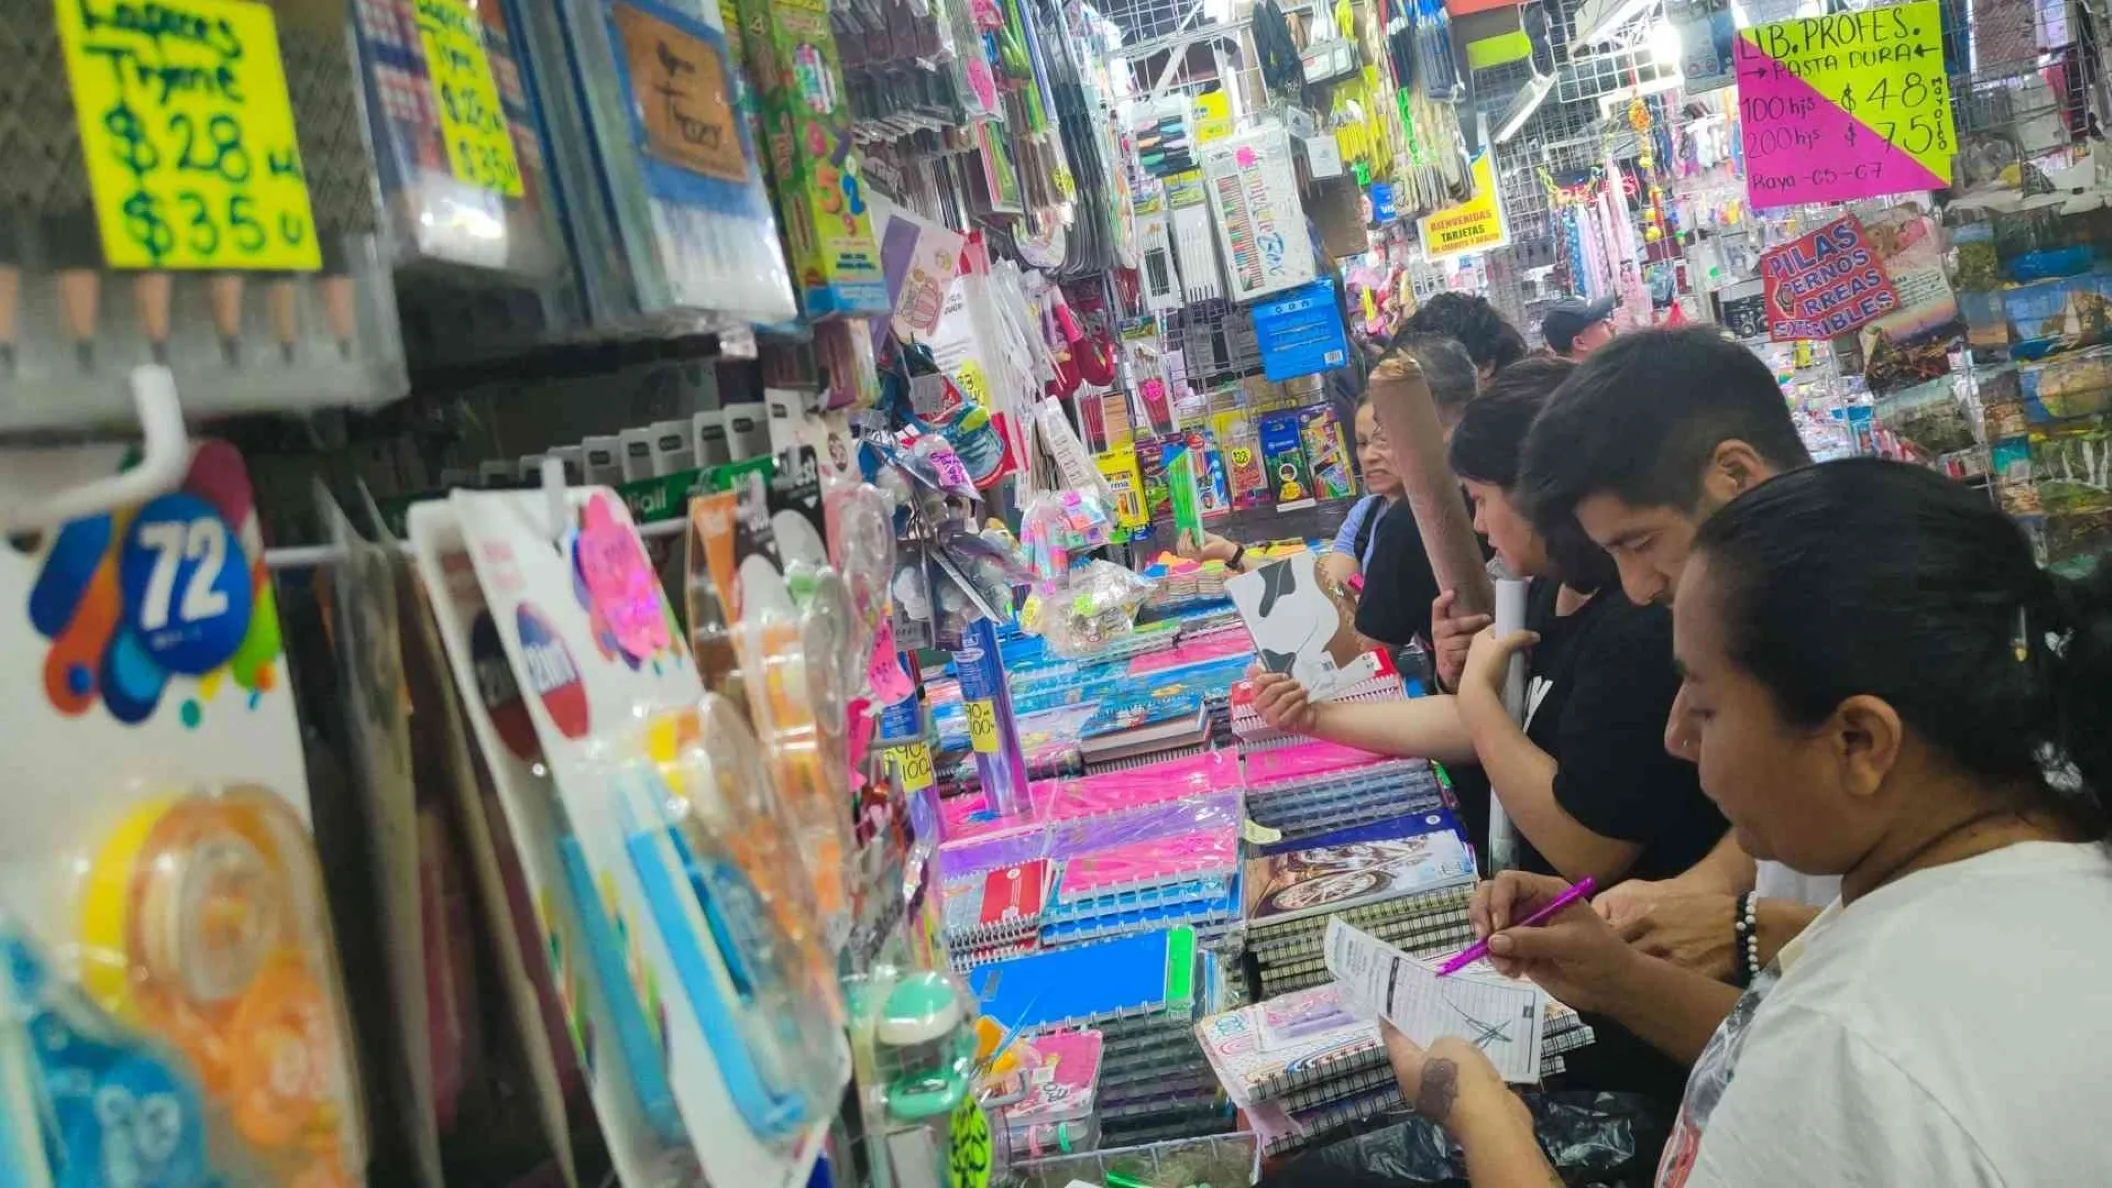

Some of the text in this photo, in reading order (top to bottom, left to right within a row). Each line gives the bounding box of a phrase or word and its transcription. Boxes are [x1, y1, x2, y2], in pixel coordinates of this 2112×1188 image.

[1773, 44, 1912, 81] PASTA DURA
[1441, 224, 1486, 242] TARJETAS
[1768, 221, 1858, 279] PILAS
[139, 516, 229, 632] 72
